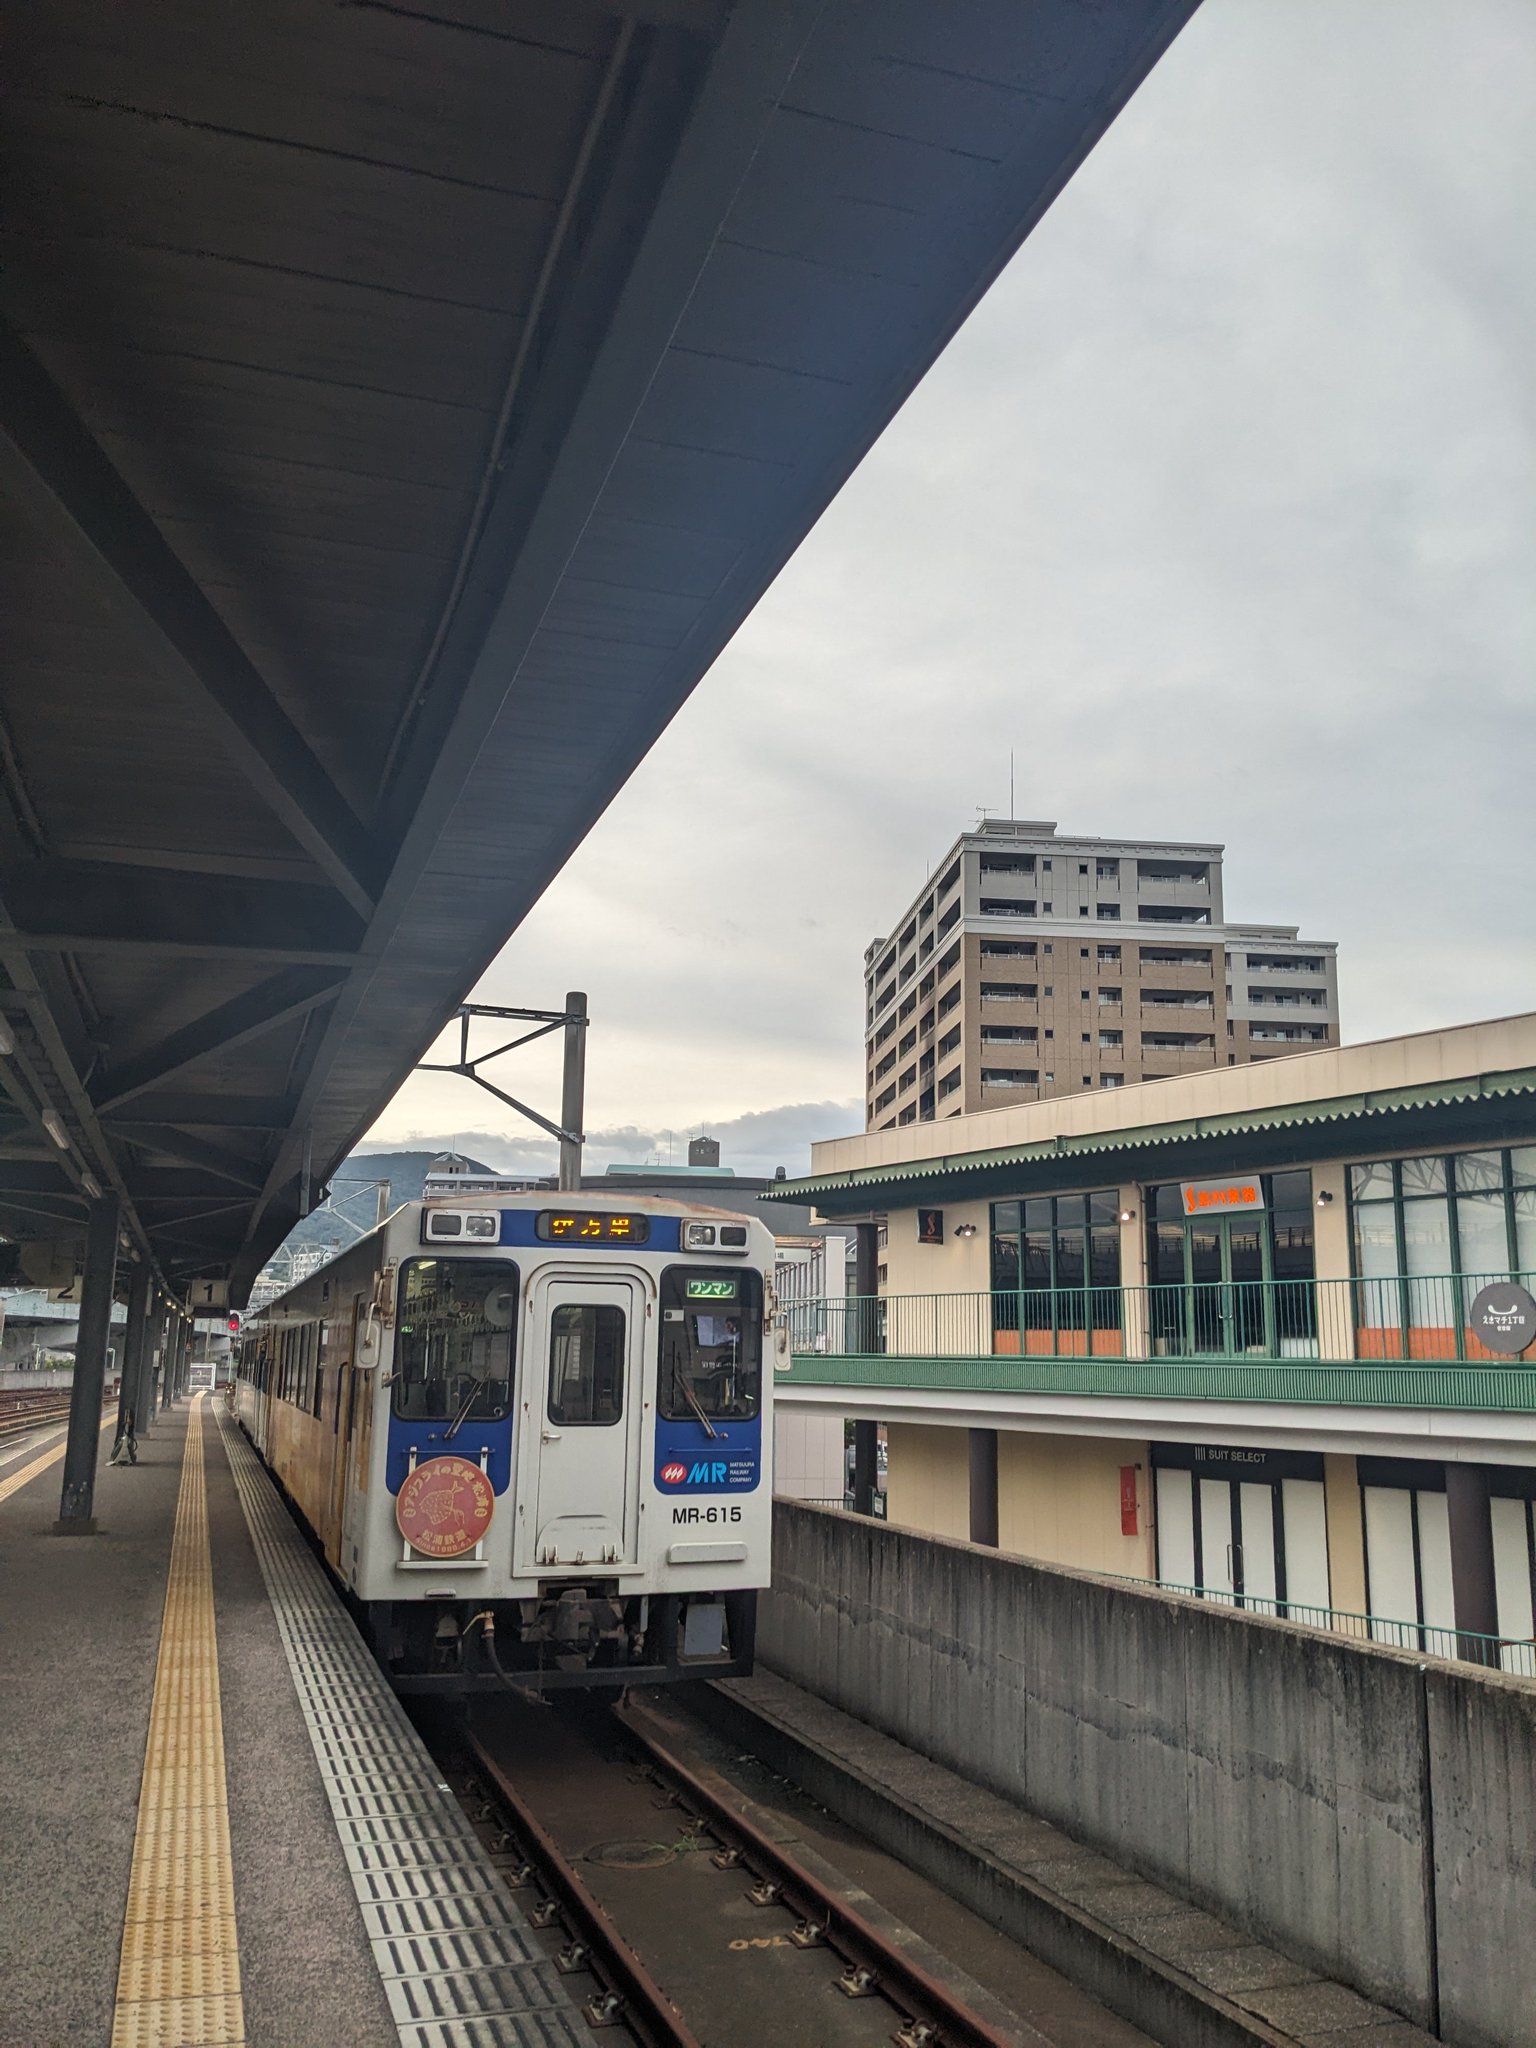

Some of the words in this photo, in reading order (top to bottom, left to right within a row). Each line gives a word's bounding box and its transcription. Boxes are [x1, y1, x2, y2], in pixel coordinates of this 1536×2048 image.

[203, 1283, 214, 1302] 1
[690, 1281, 733, 1295] ワンマン
[1208, 1449, 1229, 1461] SUIT
[1230, 1451, 1267, 1463] SELECT
[686, 1462, 727, 1484] MR
[672, 1506, 742, 1524] MR-615
